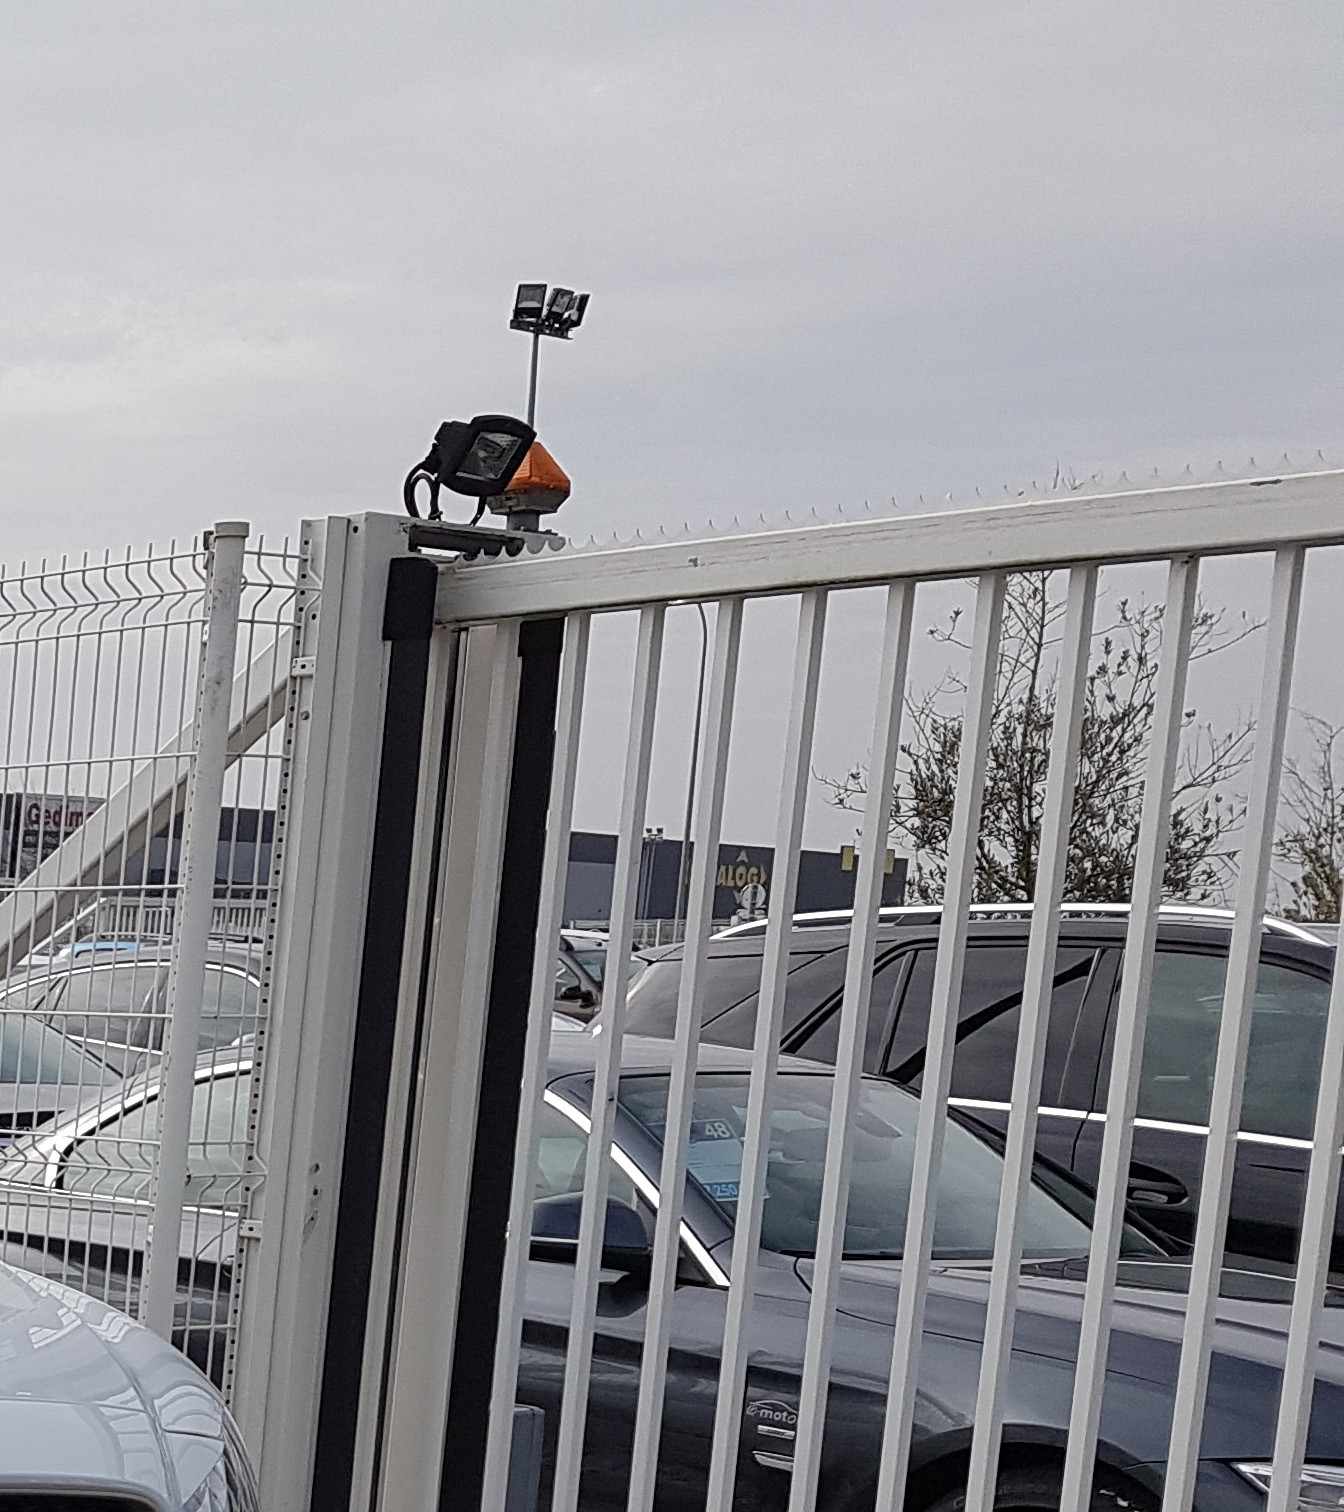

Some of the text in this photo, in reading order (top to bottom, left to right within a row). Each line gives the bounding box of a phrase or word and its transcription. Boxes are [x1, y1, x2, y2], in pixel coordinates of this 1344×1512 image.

[27, 803, 95, 827] Gedim
[715, 865, 759, 887] ALOG
[746, 1404, 798, 1425] e-moto
